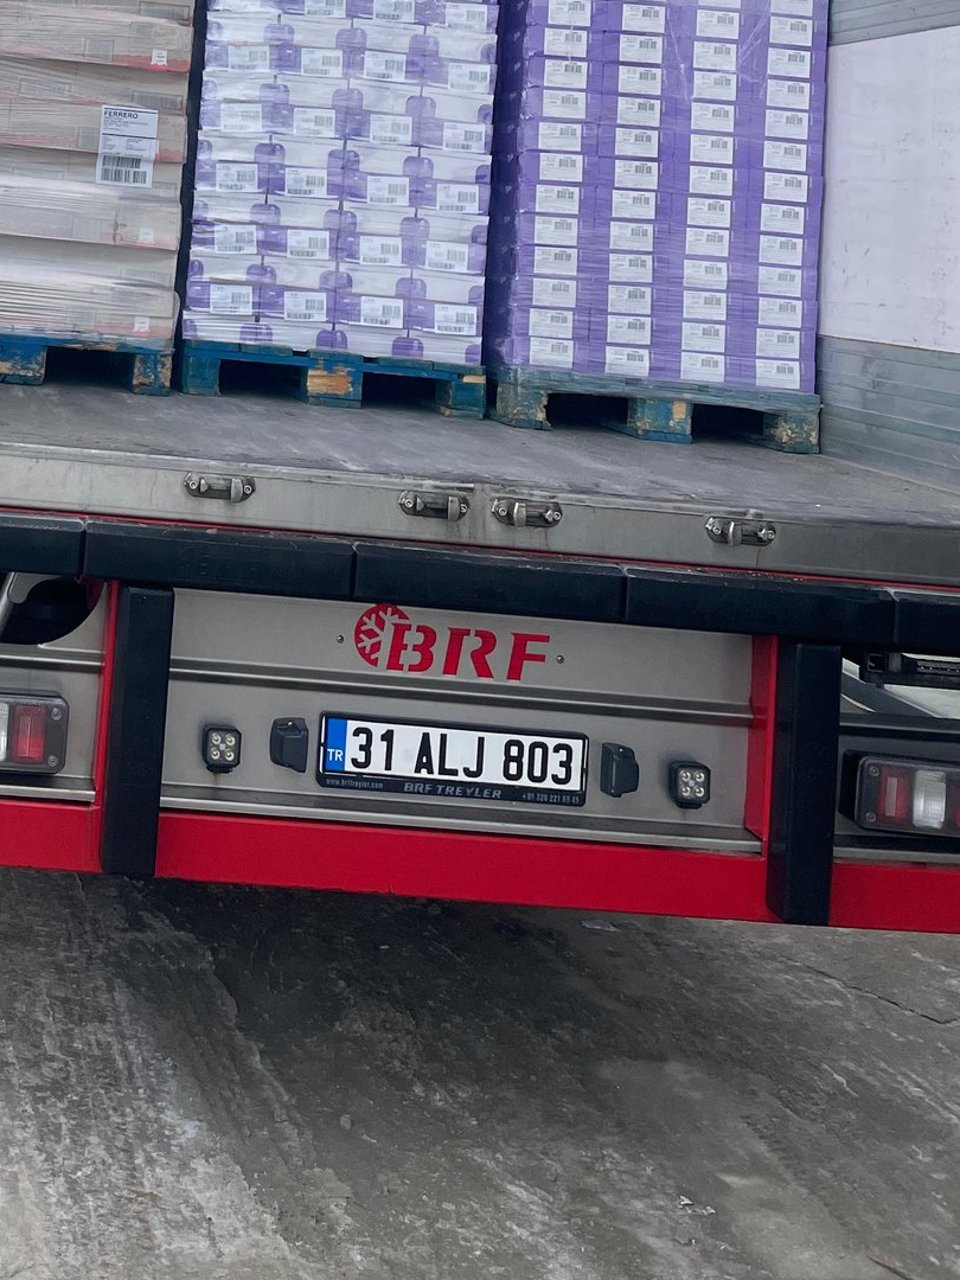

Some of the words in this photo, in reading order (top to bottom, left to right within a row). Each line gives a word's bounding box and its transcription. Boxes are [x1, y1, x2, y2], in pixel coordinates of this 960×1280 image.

[104, 111, 139, 119] FERRERO
[386, 623, 551, 681] BRF
[327, 748, 344, 762] TR
[350, 727, 396, 771] 31
[414, 732, 485, 779] ALJ
[502, 740, 574, 786] 803
[403, 782, 433, 793] BRF
[436, 784, 502, 799] TREYLER
